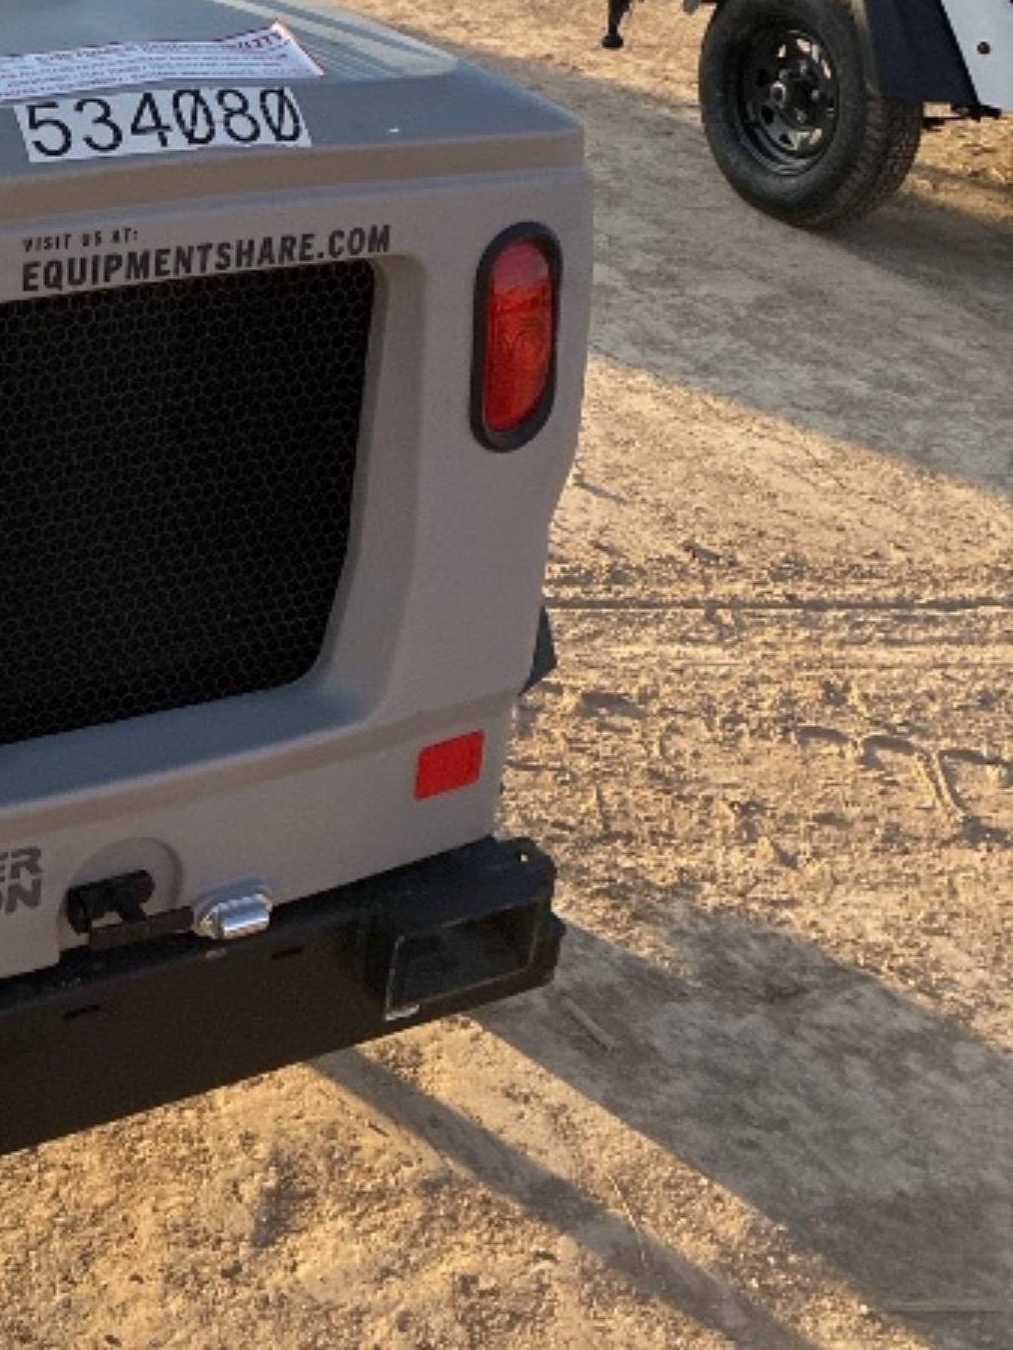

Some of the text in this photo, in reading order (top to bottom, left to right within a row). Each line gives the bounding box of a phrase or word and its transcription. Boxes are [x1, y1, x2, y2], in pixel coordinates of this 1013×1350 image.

[26, 87, 303, 157] 534080
[21, 223, 392, 293] EQUIPMENTSHARE.COM
[23, 231, 72, 253] VISIT
